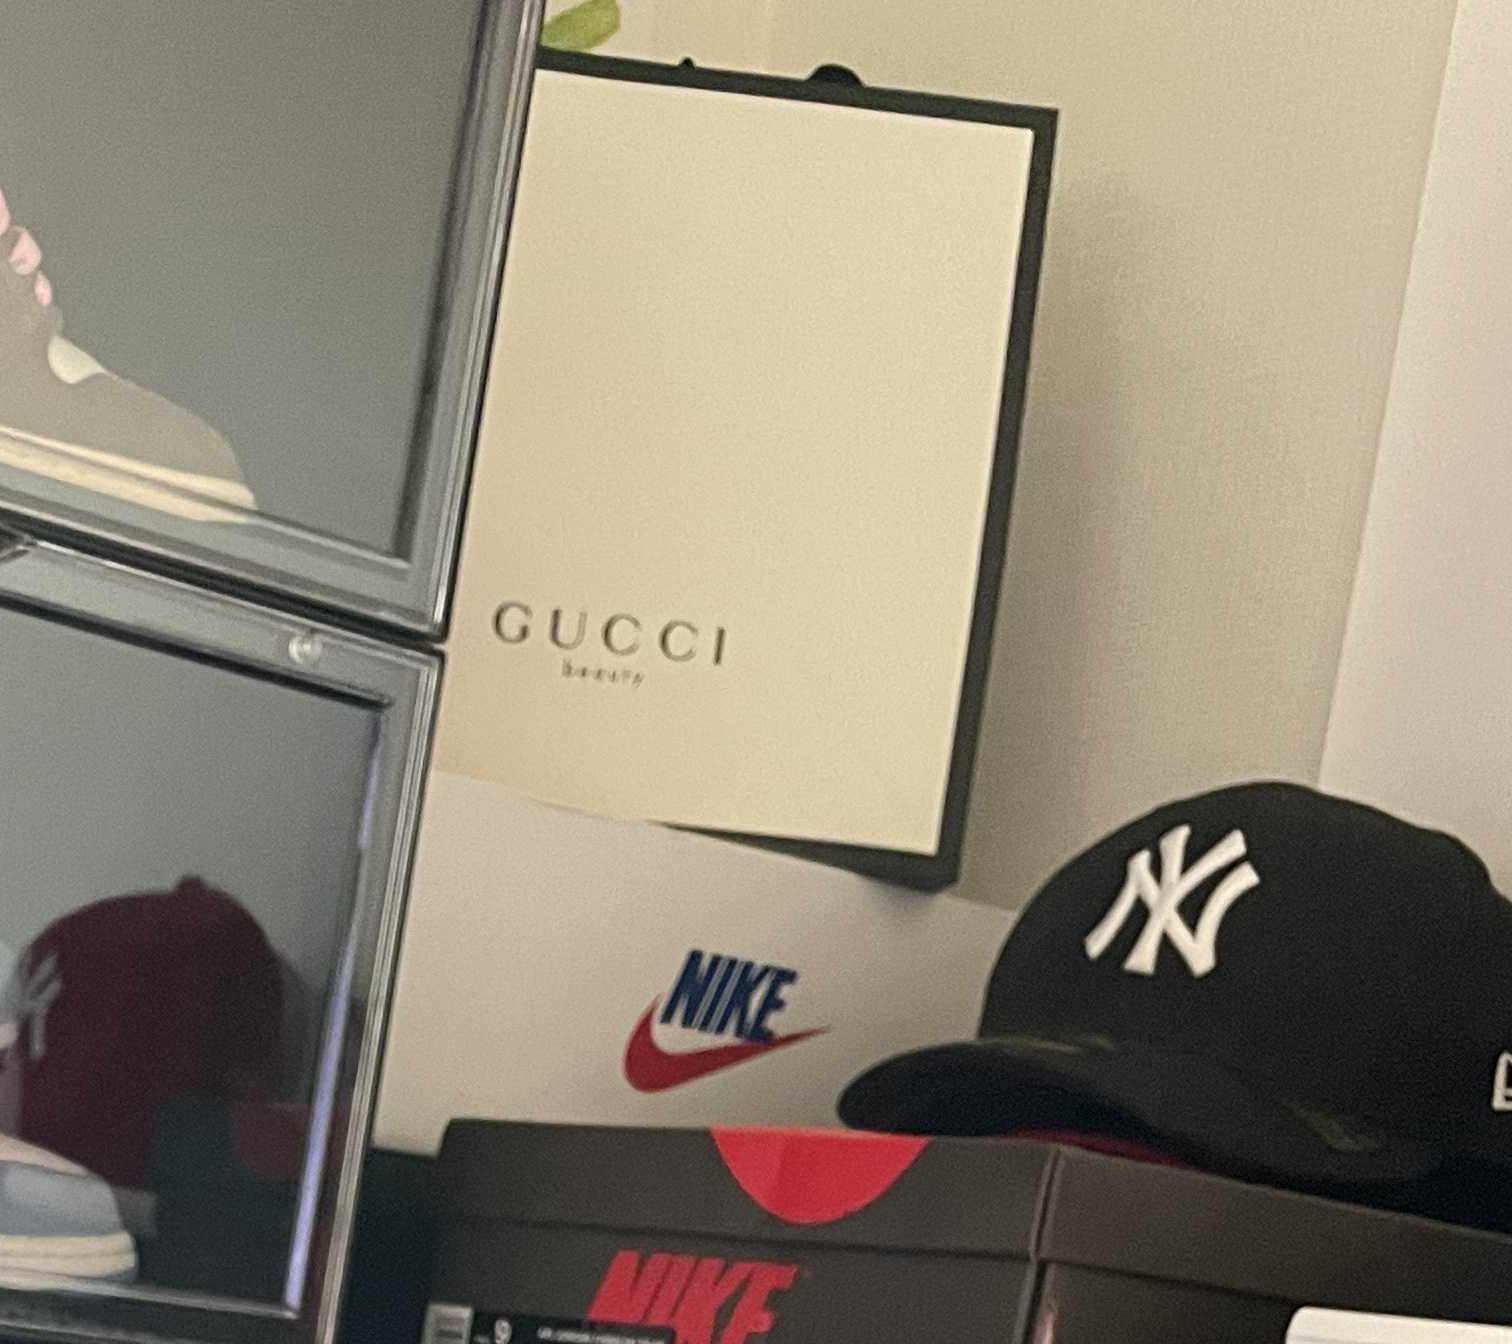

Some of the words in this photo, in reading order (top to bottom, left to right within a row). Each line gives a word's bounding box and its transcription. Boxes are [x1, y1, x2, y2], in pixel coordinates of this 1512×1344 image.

[492, 601, 727, 666] GUCCI
[1085, 825, 1260, 978] NY
[660, 949, 798, 1044] NIKE
